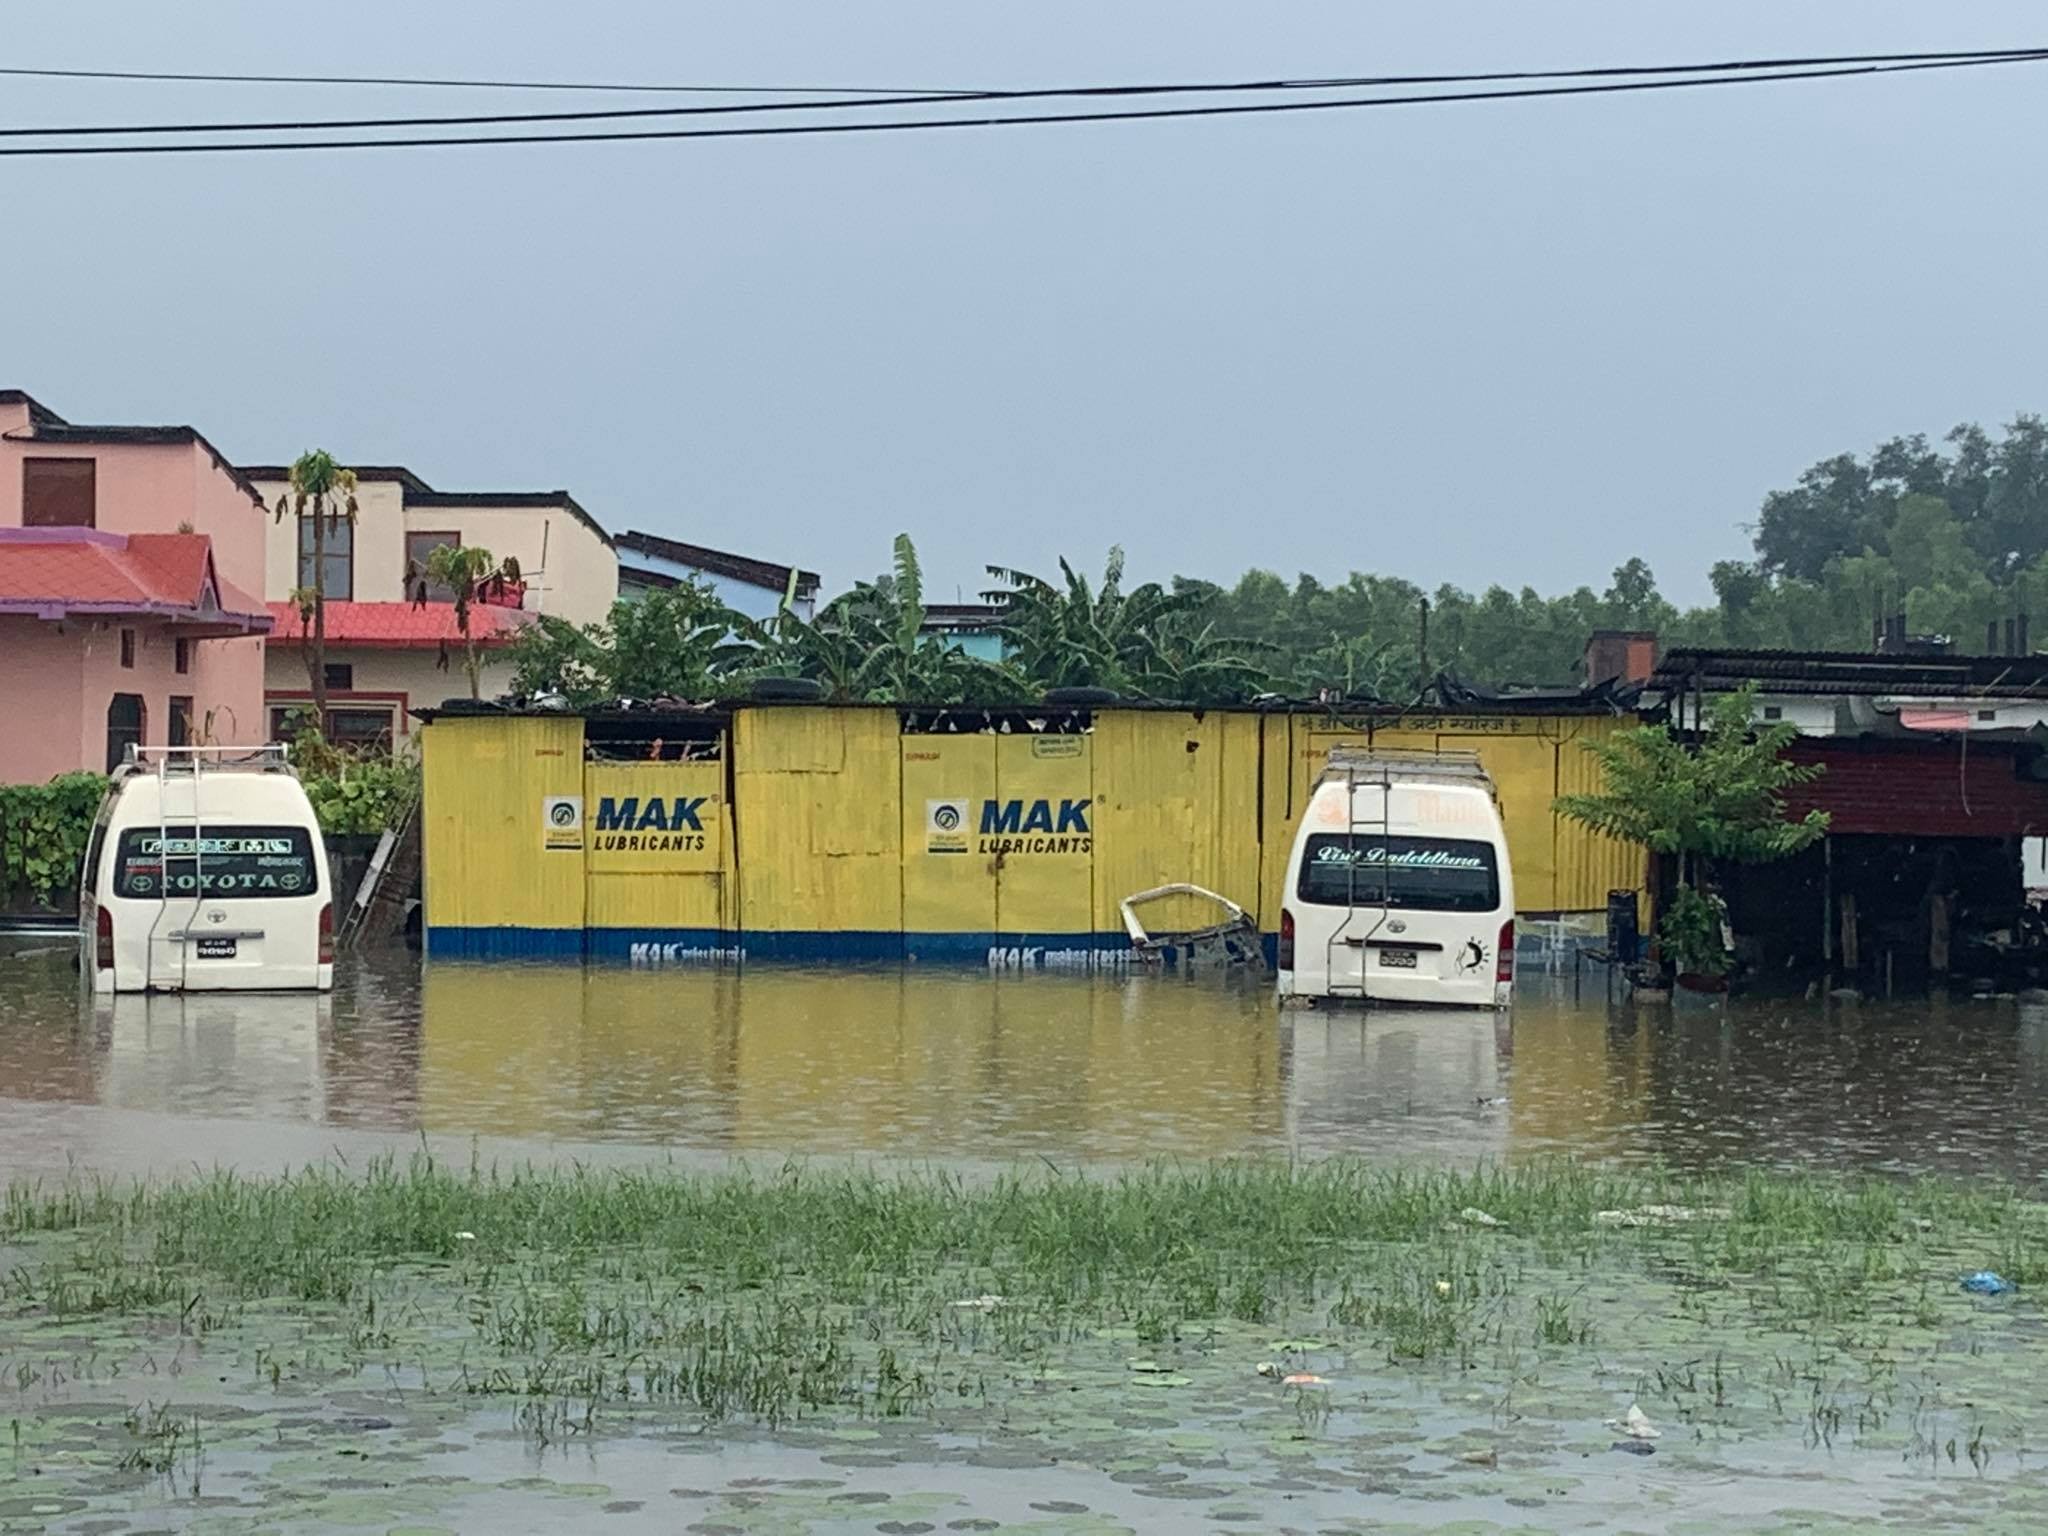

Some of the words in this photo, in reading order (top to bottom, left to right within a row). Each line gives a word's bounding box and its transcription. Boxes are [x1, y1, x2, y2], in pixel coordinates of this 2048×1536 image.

[594, 797, 708, 831] MAK
[979, 800, 1093, 834] MAK
[594, 836, 705, 851] LUBRICANTS
[979, 838, 1092, 854] LUBRICANTS
[1317, 846, 1361, 862] Visit
[160, 874, 278, 889] TOYOTA
[988, 947, 1041, 962] MAK
